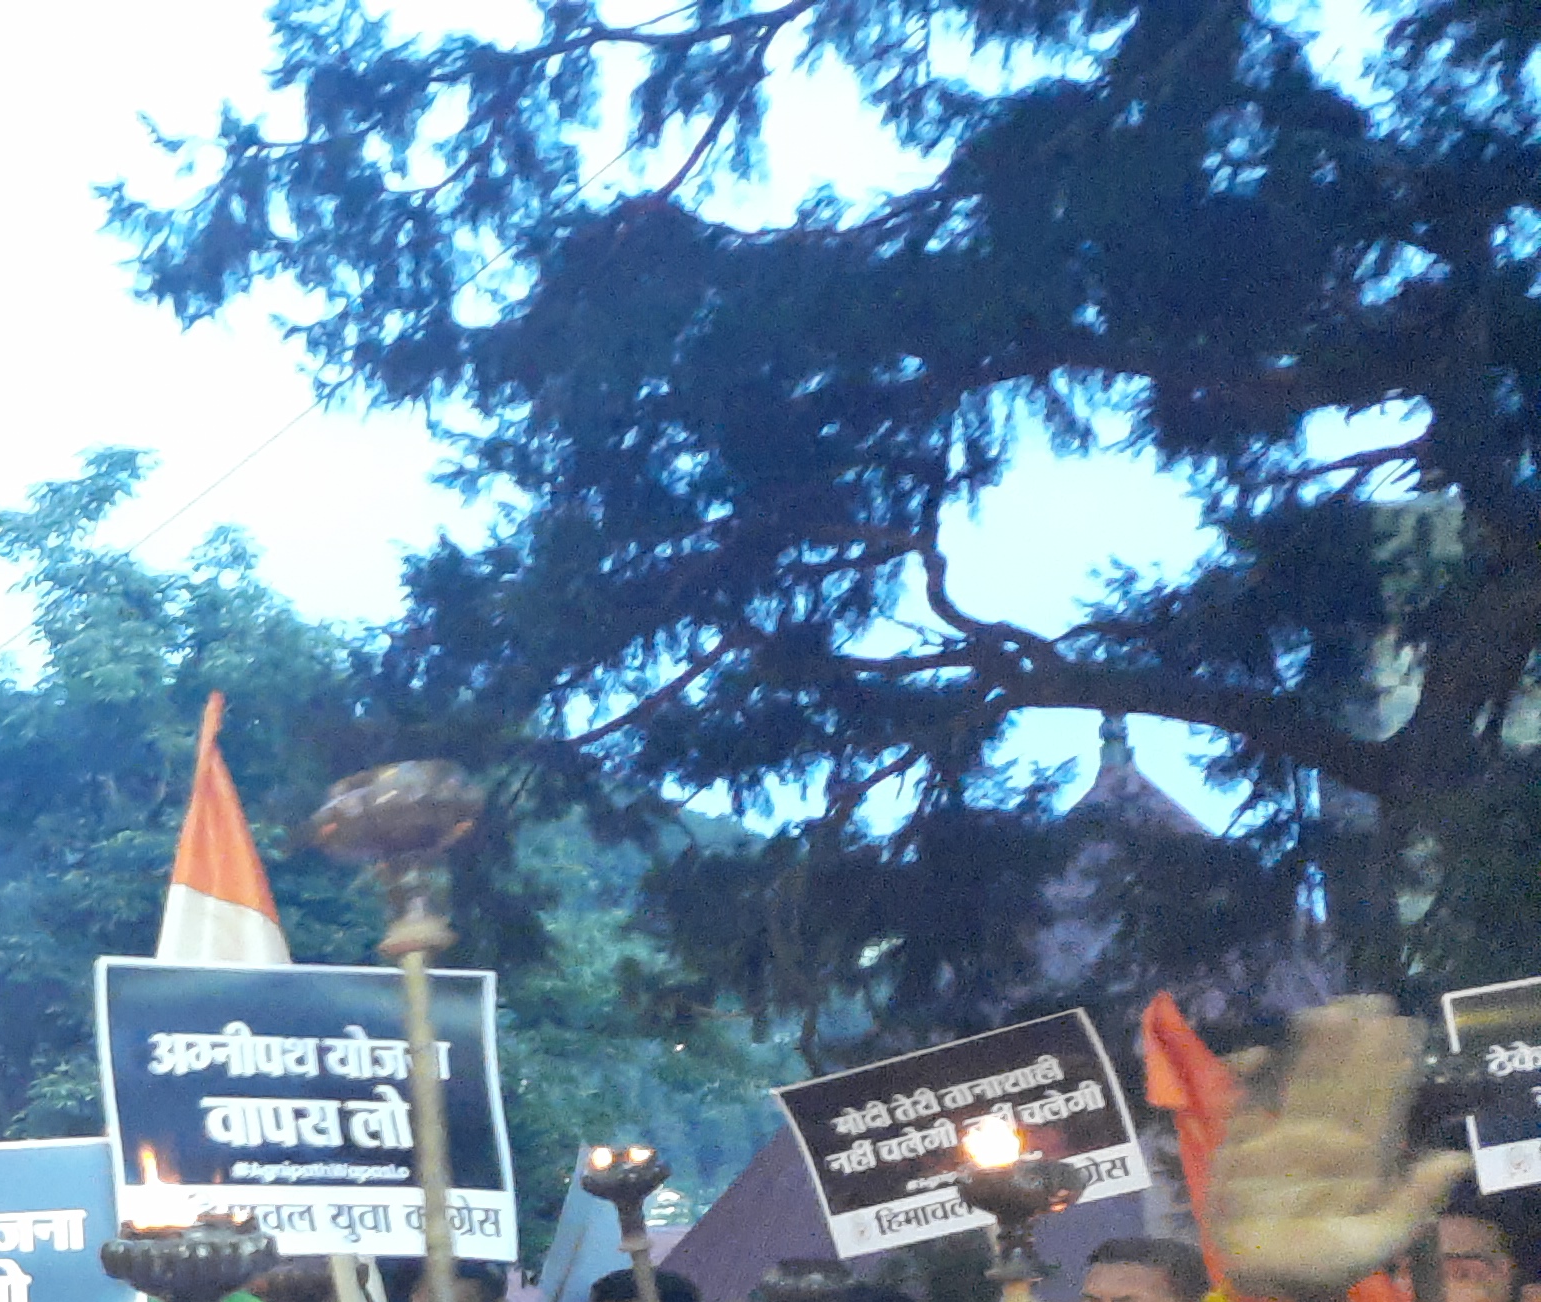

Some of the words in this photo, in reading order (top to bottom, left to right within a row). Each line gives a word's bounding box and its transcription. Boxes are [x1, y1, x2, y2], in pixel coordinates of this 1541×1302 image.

[200, 1096, 344, 1149] वापस
[344, 1084, 414, 1150] लो
[824, 1138, 877, 1175] नहीं
[875, 1117, 958, 1162] चलेगी
[1017, 1079, 1106, 1126] चलेगी
[829, 1099, 894, 1136] मोदी
[889, 1087, 941, 1123] तेरी
[937, 1054, 1065, 1111] तानाशाही
[329, 1203, 392, 1242] युवा
[874, 1198, 976, 1237] हिमाचल
